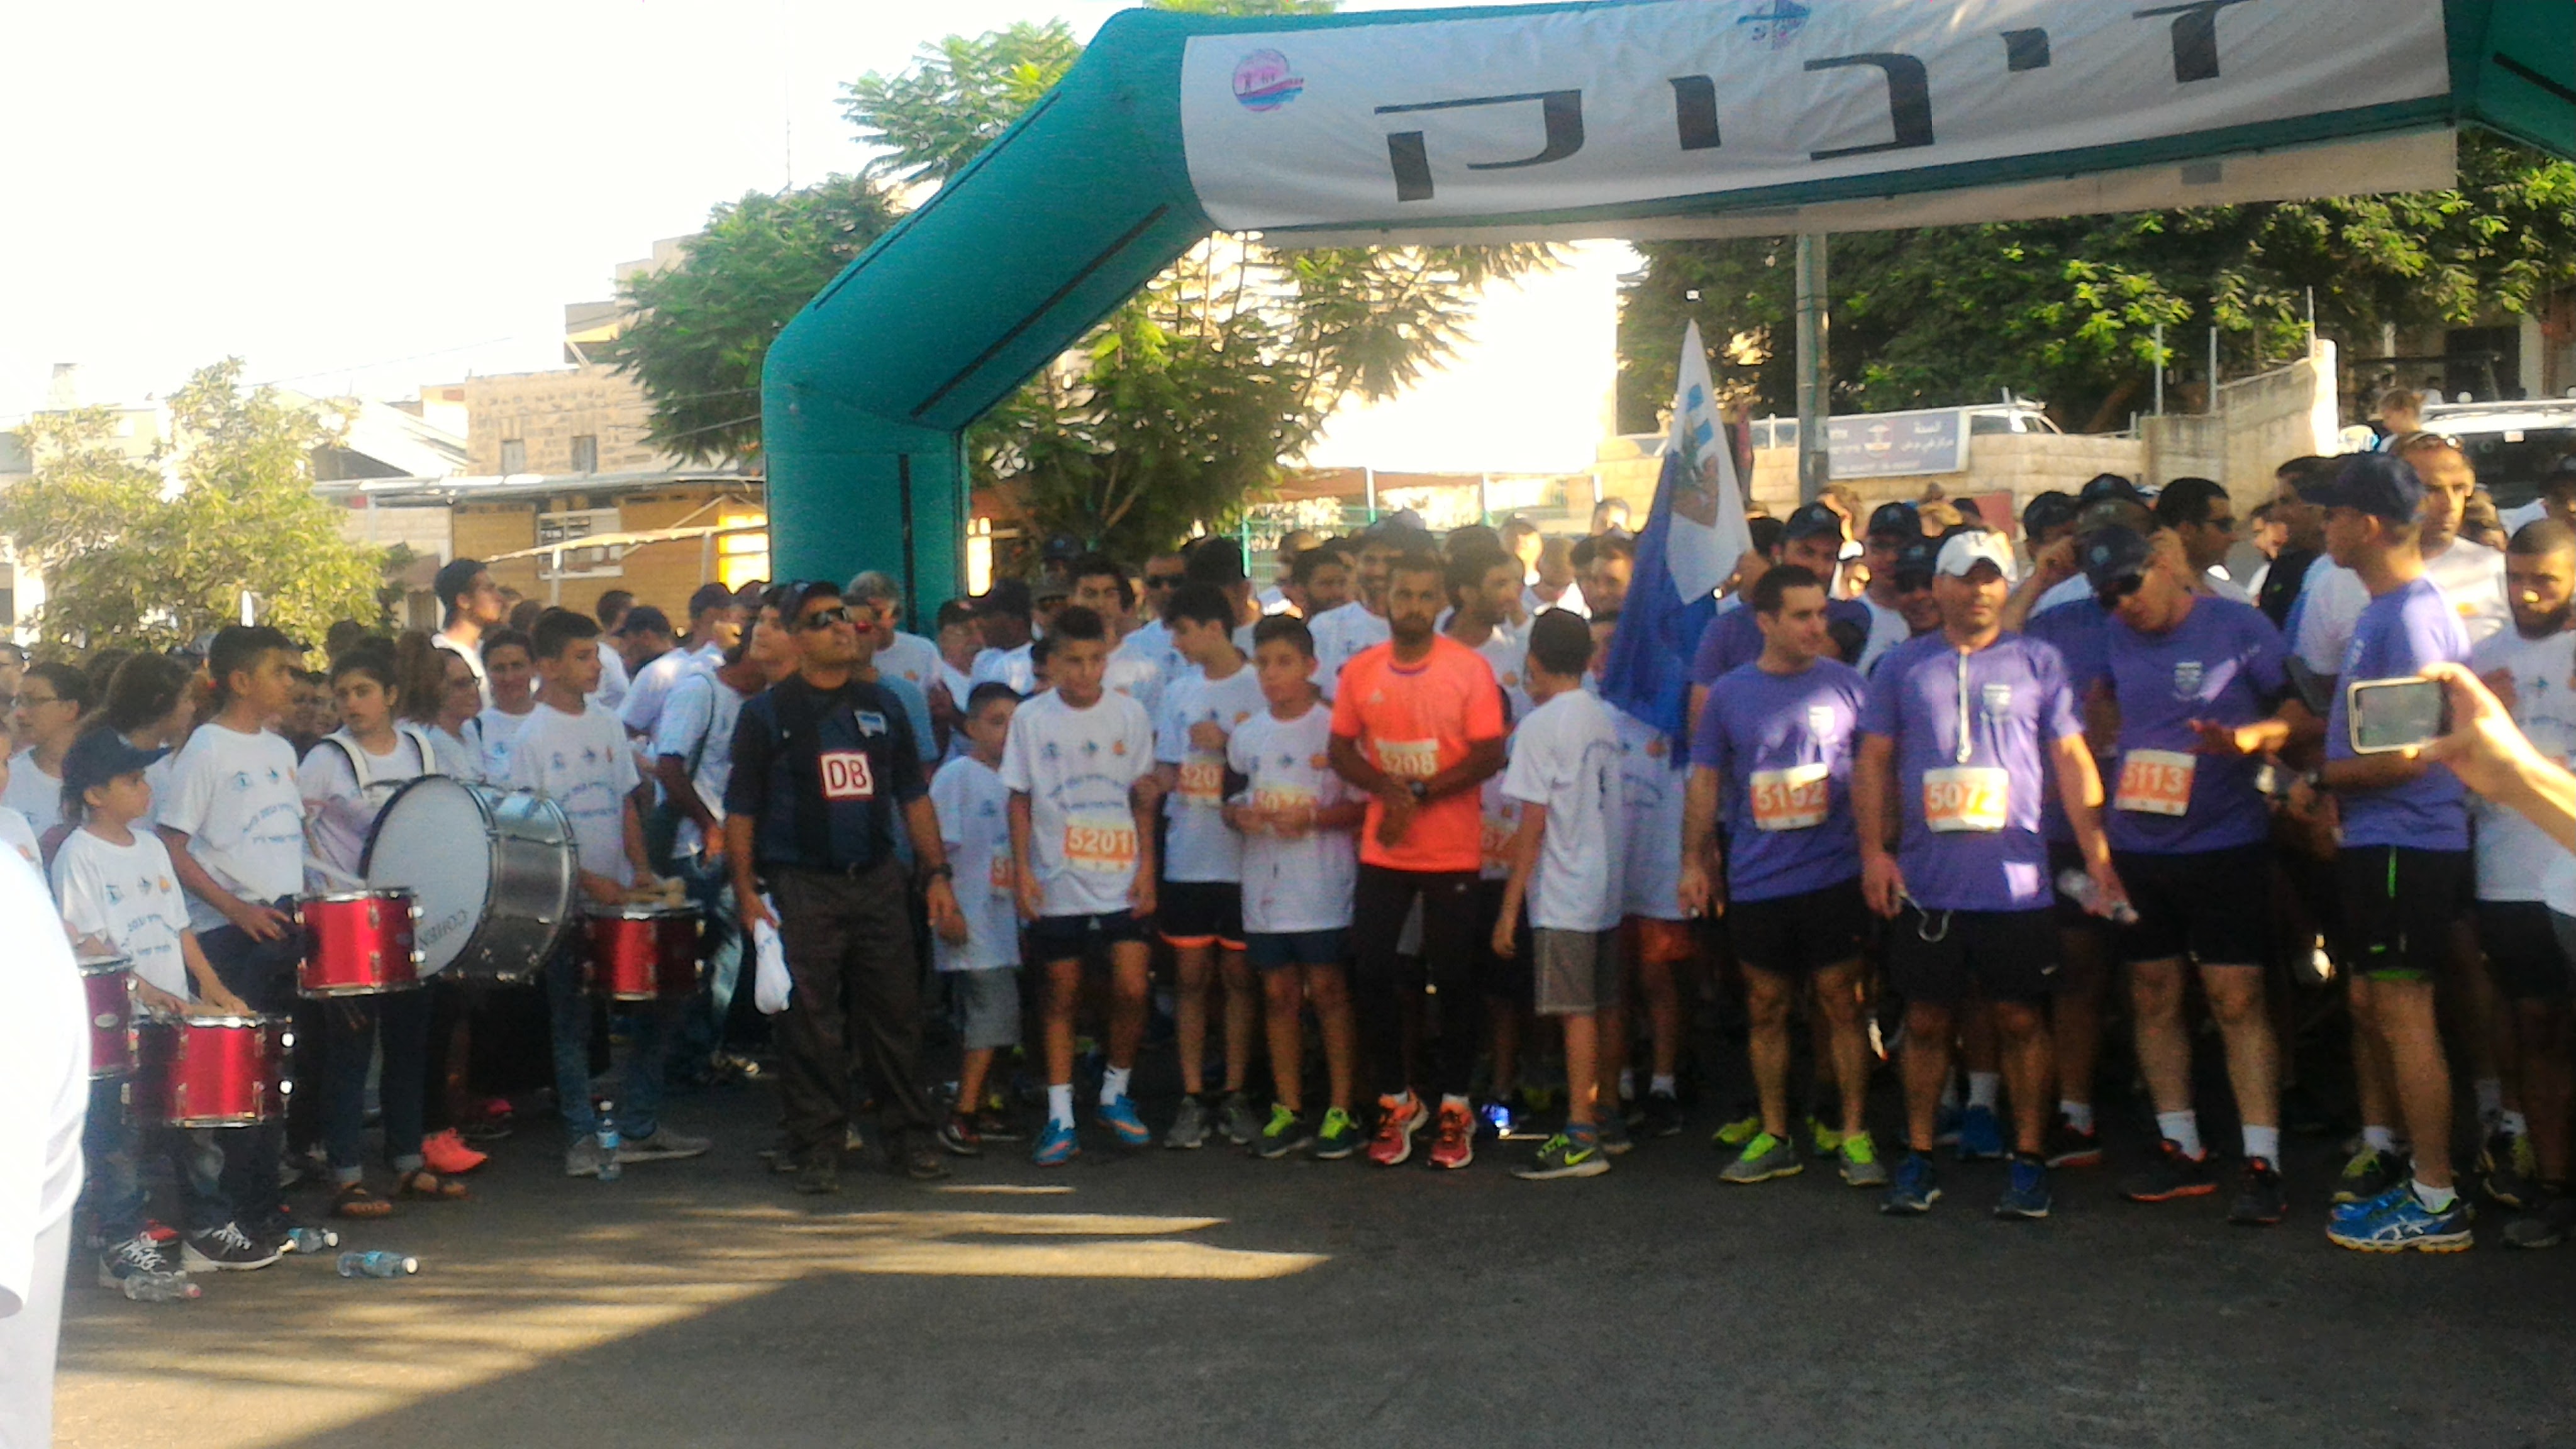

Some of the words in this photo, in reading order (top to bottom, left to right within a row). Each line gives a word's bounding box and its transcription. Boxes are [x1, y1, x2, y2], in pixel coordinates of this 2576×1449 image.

[1375, 0, 2255, 202] זינוק
[829, 759, 867, 790] DB
[1069, 826, 1131, 853] 5201
